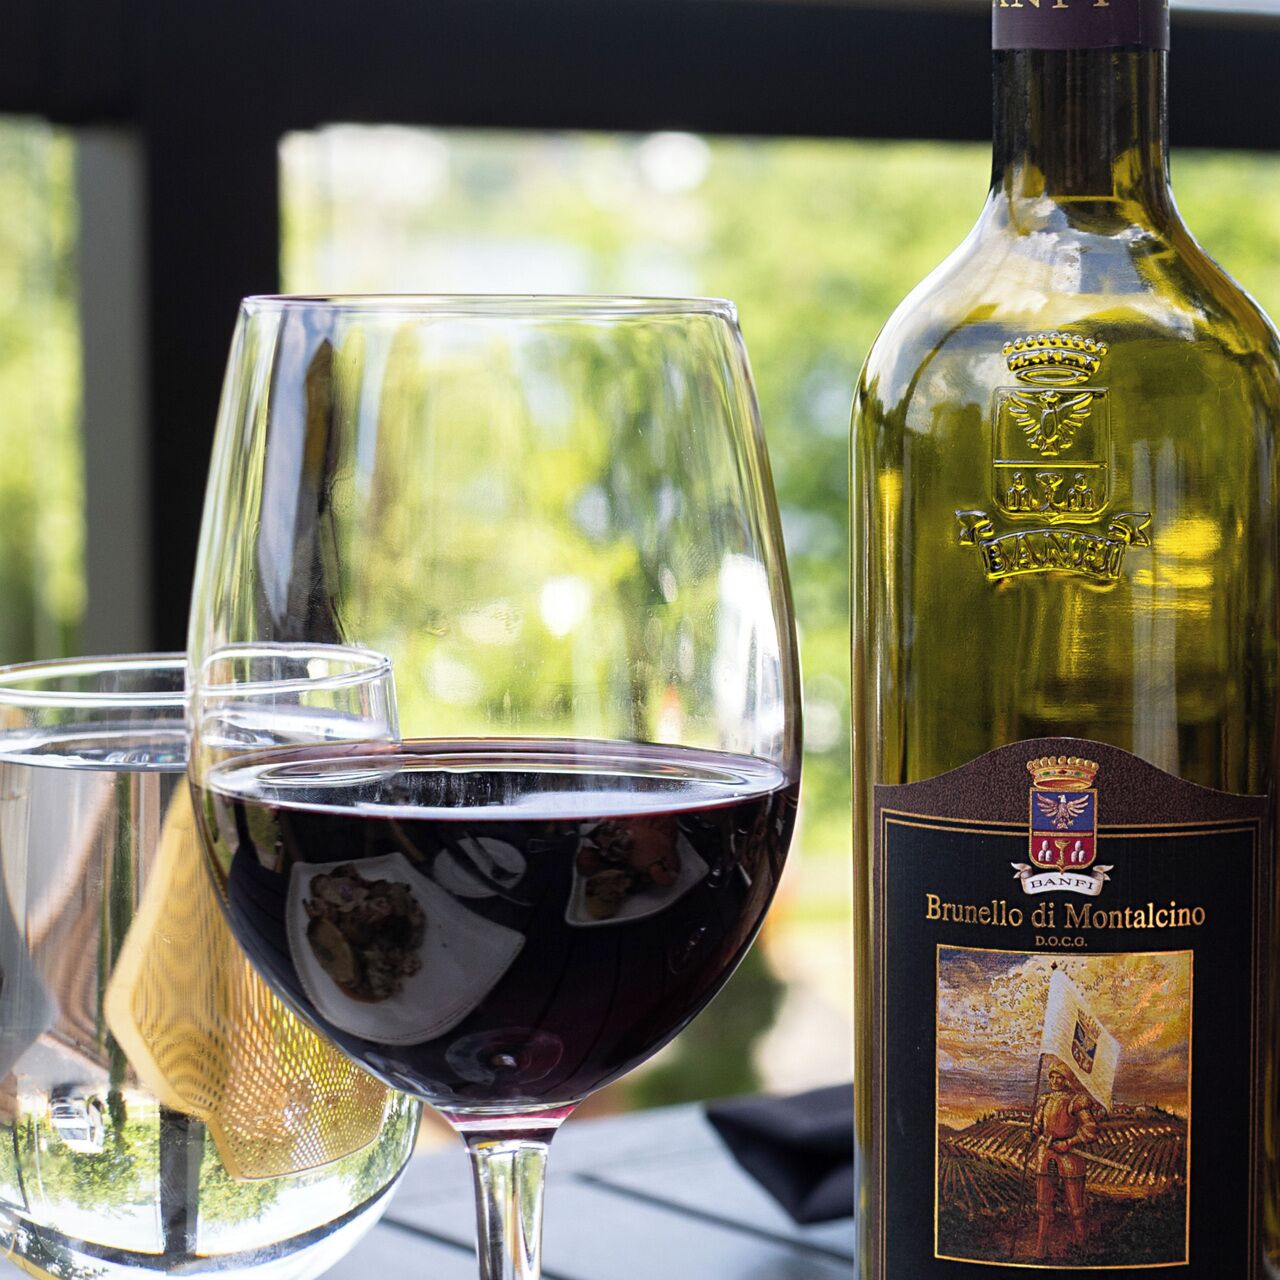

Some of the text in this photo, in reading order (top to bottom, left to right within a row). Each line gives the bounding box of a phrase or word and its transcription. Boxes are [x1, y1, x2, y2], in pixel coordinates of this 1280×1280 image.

[982, 531, 1125, 579] BANFI
[1030, 877, 1094, 890] BANFI
[925, 893, 1206, 929] Brunello di Montalcino
[1035, 935, 1088, 947] D.O.C.G.
